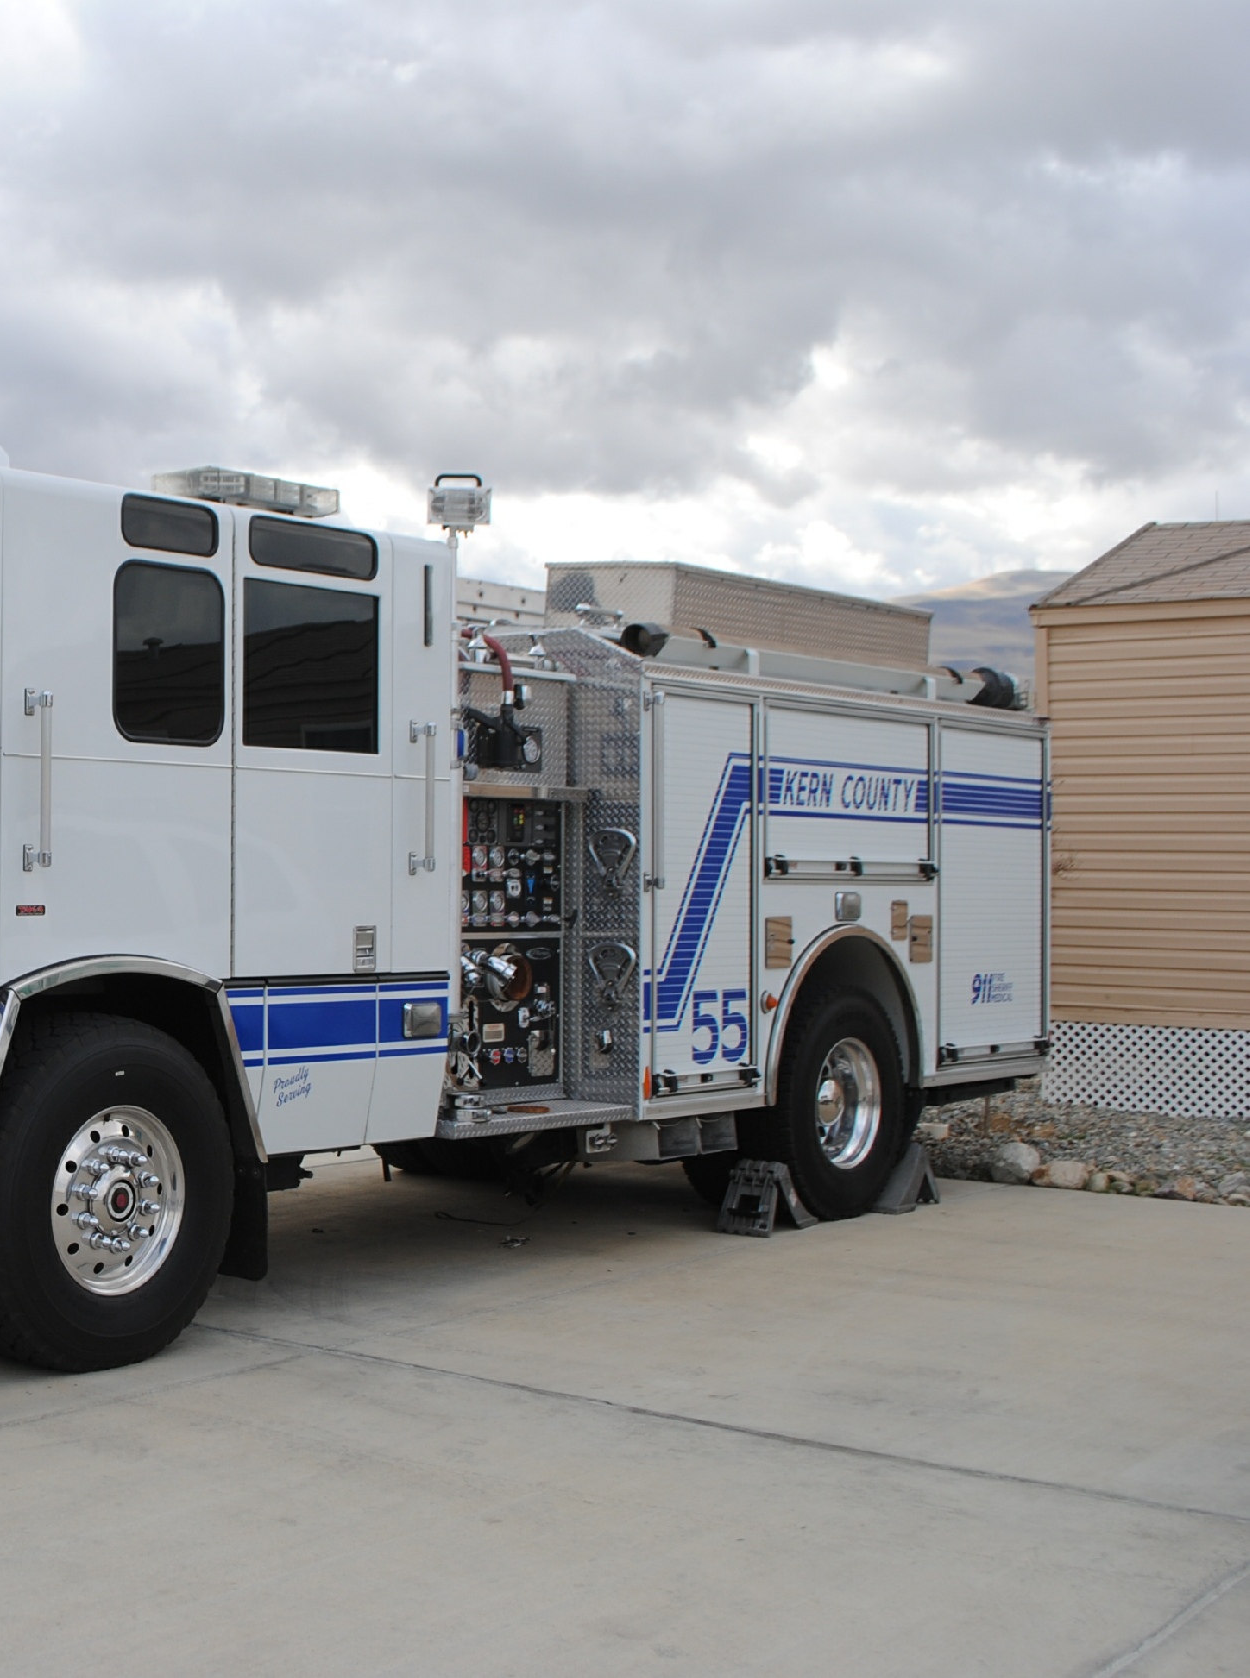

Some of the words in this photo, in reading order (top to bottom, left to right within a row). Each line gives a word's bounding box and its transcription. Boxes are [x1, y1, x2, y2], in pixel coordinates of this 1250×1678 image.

[783, 770, 835, 808] KERN
[841, 775, 915, 812] COUNTY
[971, 973, 992, 1005] 911
[692, 988, 747, 1065] 55
[273, 1066, 309, 1093] Proudly
[276, 1083, 311, 1107] Serving
